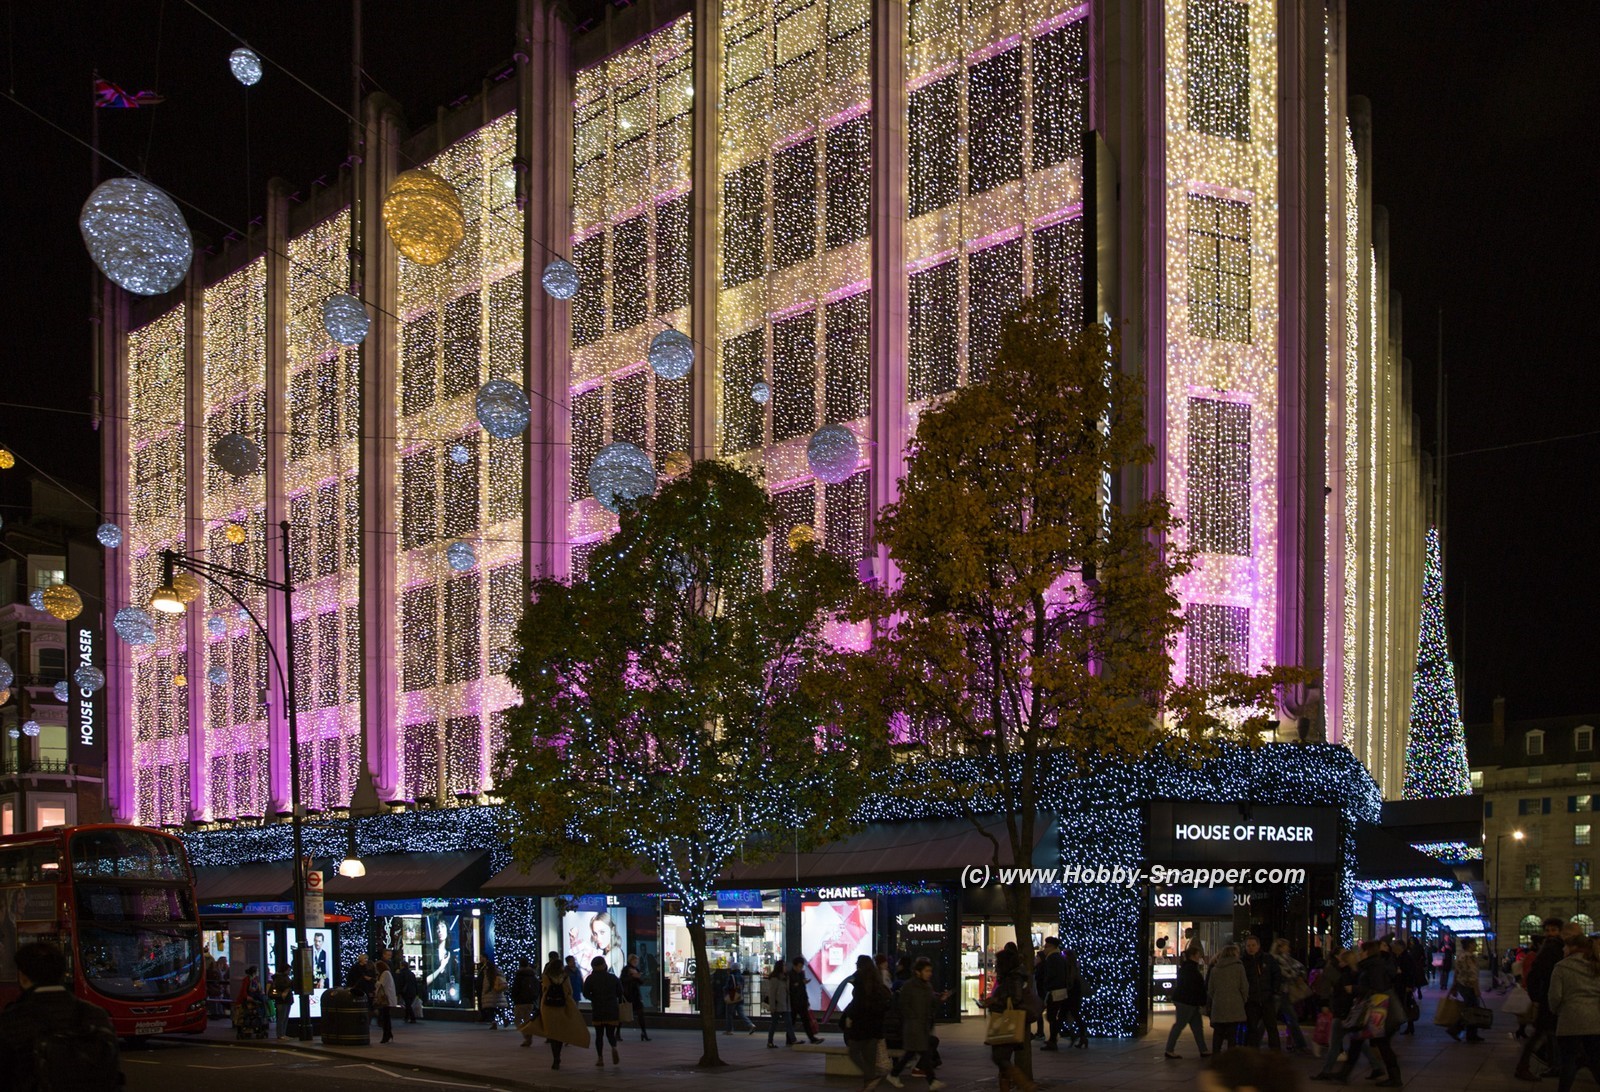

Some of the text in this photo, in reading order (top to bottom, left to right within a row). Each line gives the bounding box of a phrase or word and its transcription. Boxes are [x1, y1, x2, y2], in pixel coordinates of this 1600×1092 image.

[80, 629, 93, 667] RASER
[80, 699, 93, 746] HOUSE
[1175, 824, 1314, 842] HOUSE OF FRASER
[743, 891, 760, 903] GIFT
[818, 886, 867, 900] CHANEL
[245, 904, 291, 913] CLINIQUE GIFT
[377, 902, 404, 911] CLINIQUE
[404, 901, 421, 911] GIFT
[907, 923, 946, 933] CHANEL
